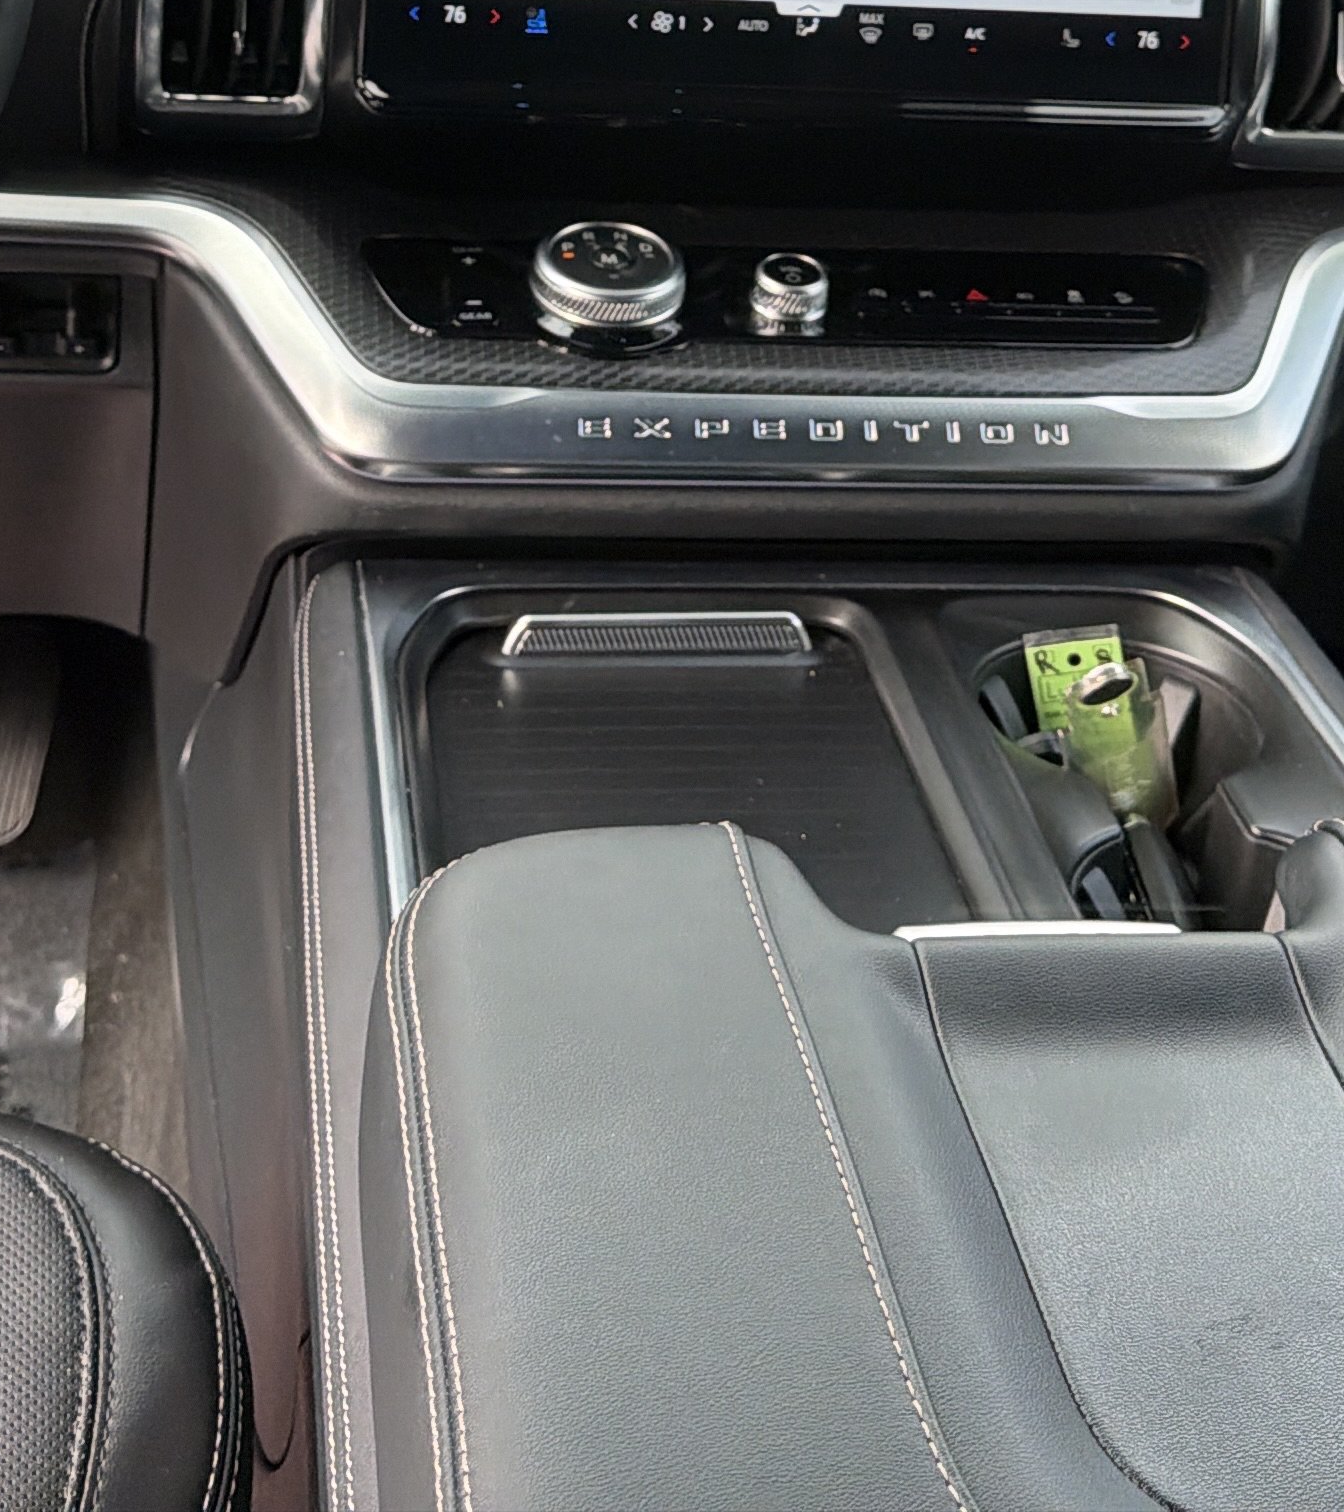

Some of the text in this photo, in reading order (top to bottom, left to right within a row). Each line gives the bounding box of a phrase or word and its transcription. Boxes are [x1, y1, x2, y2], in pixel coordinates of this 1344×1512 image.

[443, 4, 467, 24] 76
[858, 12, 885, 25] MAX
[737, 18, 770, 32] AUTO
[964, 27, 987, 41] A/C
[1136, 30, 1160, 50] 76
[600, 253, 619, 265] M
[577, 417, 1071, 447] EXPEDITION
